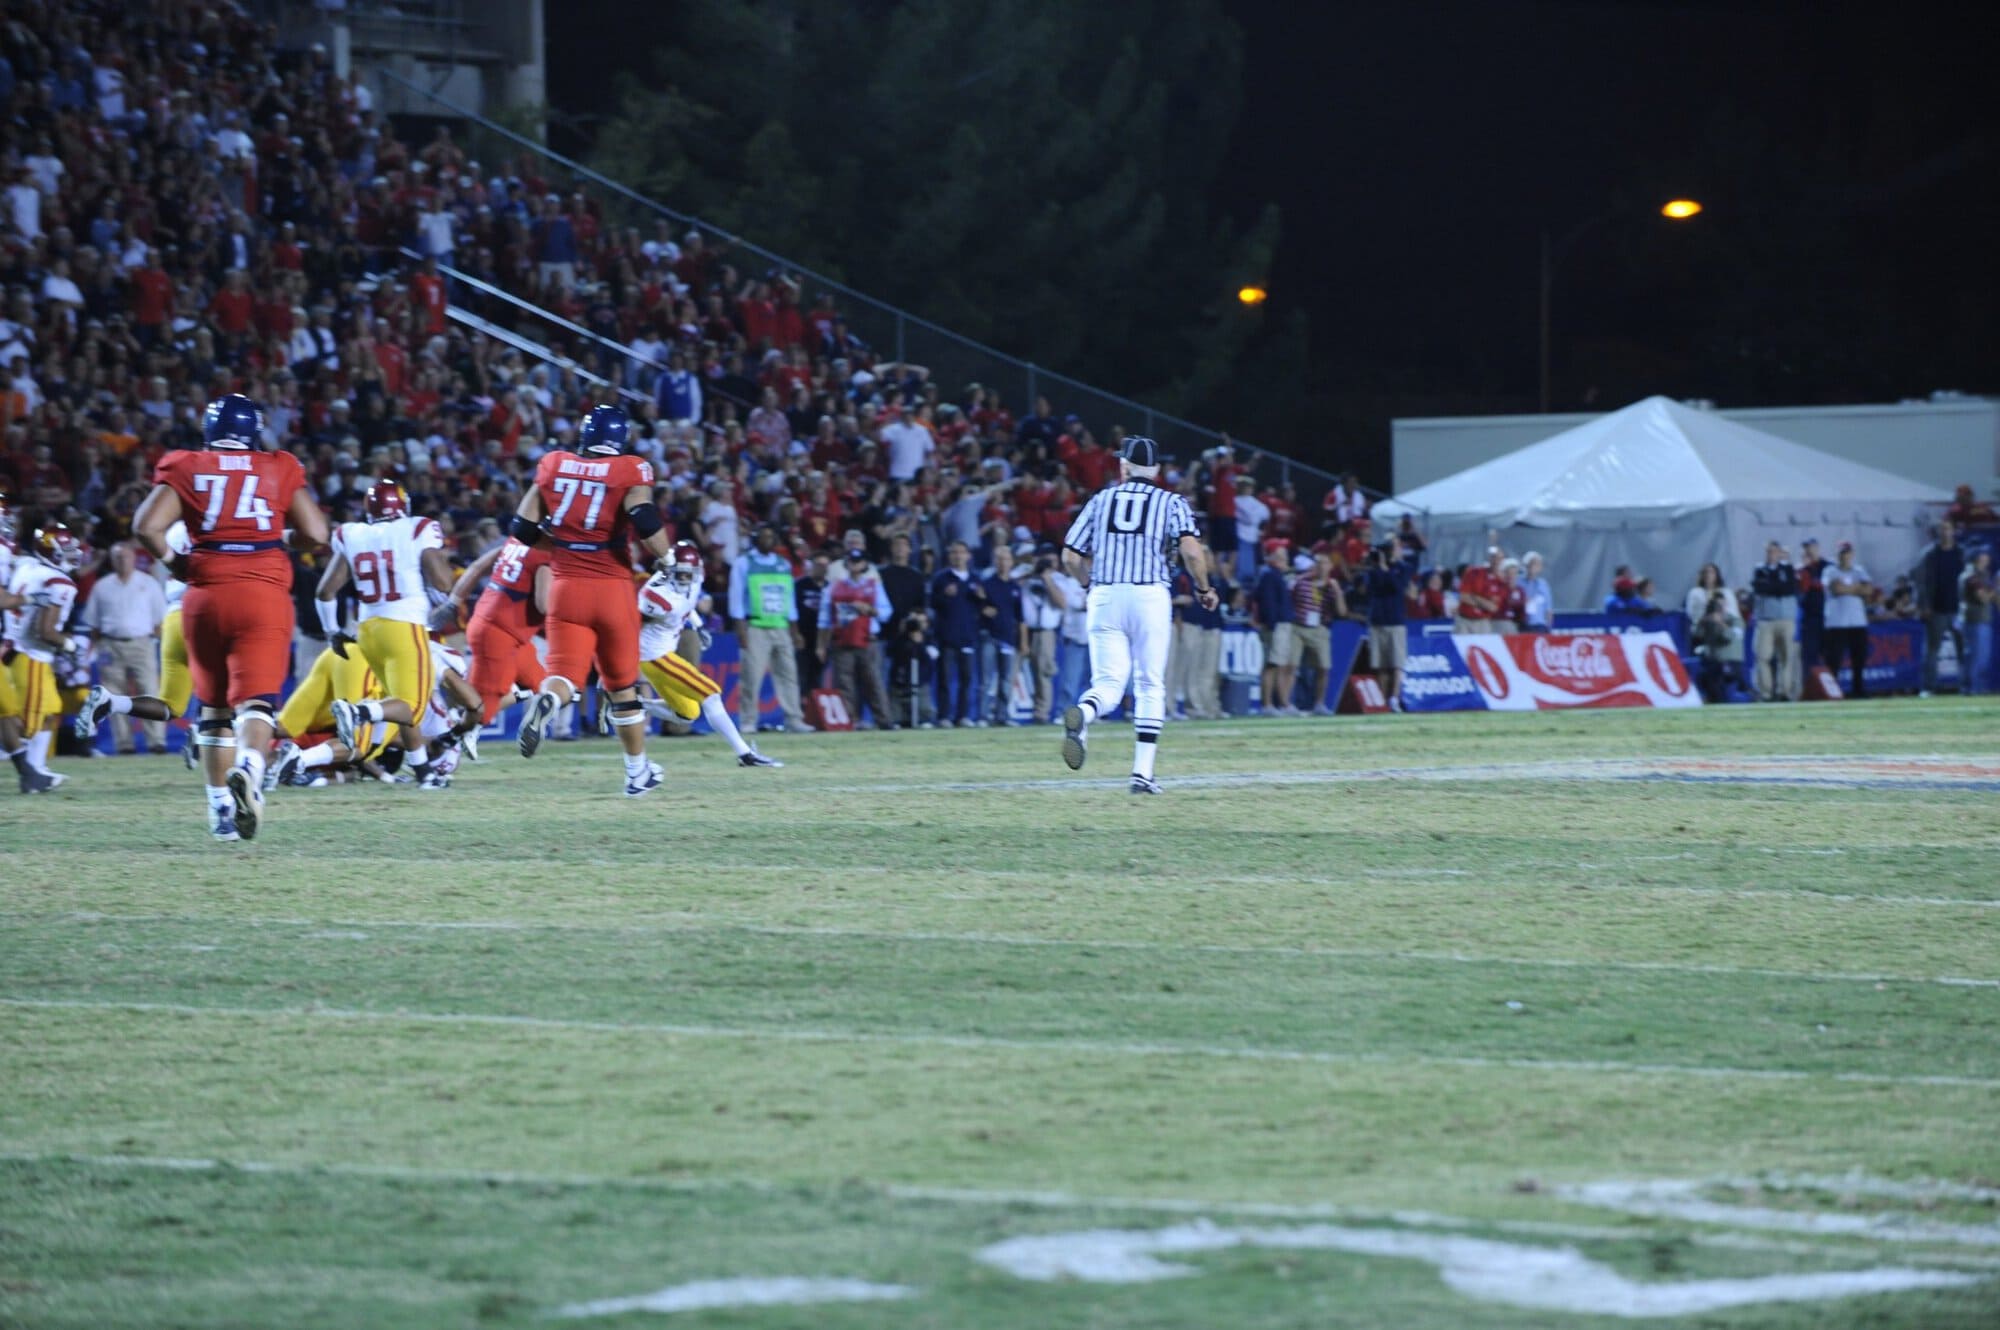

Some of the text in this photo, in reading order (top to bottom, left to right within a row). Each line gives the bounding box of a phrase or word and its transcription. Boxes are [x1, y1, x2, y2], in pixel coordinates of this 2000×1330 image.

[193, 474, 274, 531] 74
[551, 477, 606, 530] 77
[1113, 493, 1149, 531] U
[353, 550, 403, 604] 91
